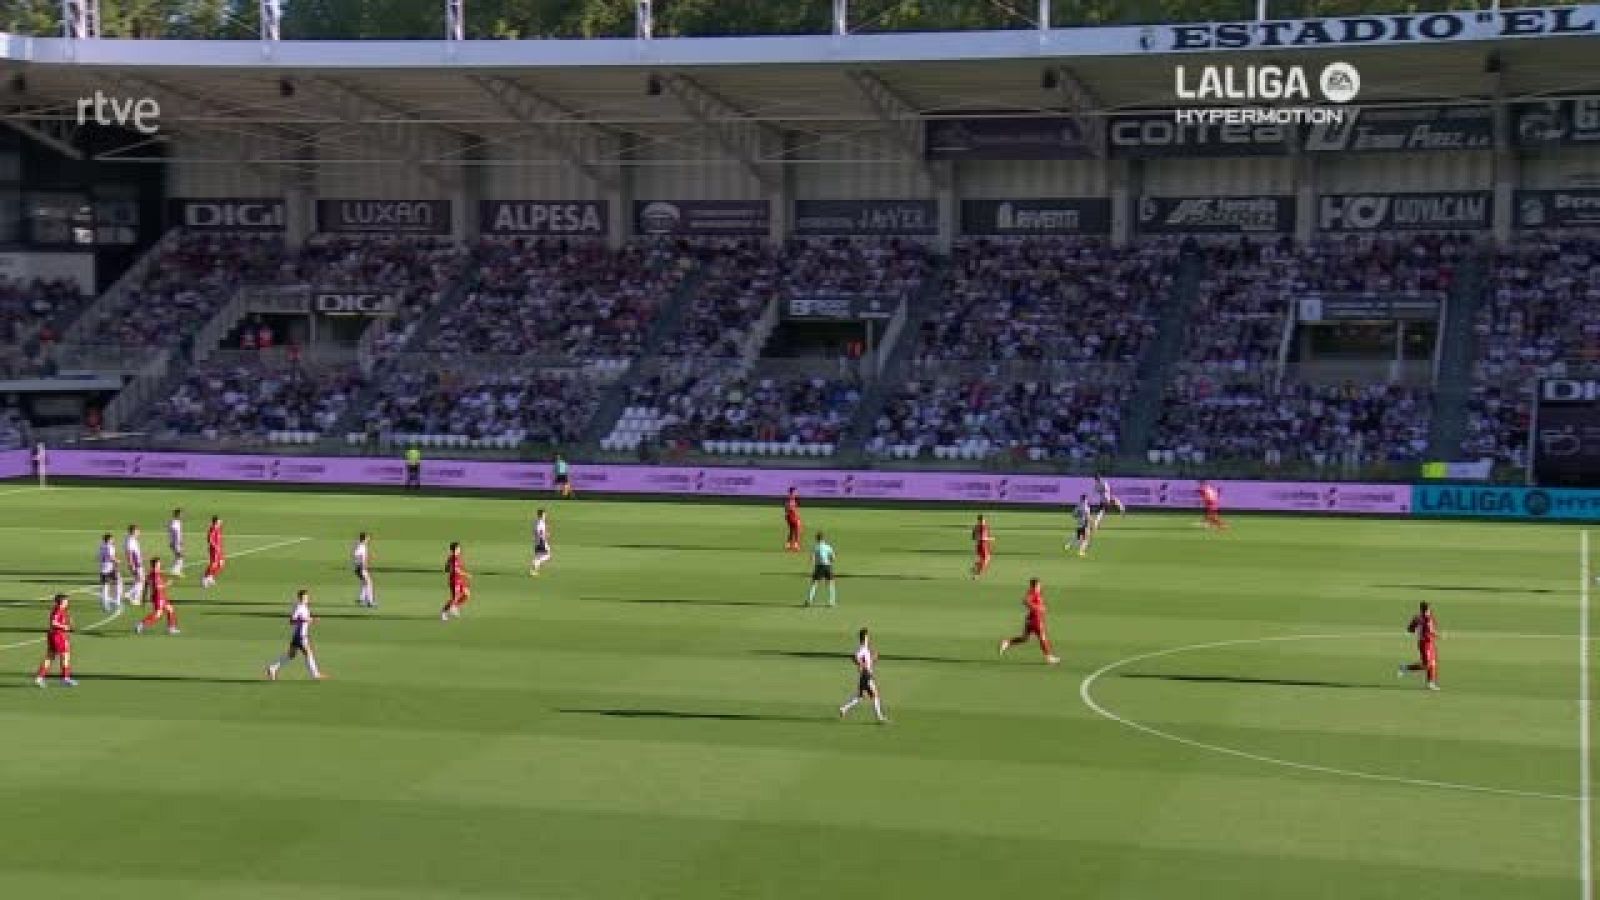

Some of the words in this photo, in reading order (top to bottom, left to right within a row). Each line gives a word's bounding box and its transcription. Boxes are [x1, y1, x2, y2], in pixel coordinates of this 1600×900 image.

[1171, 14, 1465, 51] ESTADIO
[185, 204, 283, 226] DIGI
[494, 204, 600, 231] ALPESA
[1544, 380, 1600, 400] DI
[1420, 488, 1517, 512] LALIGA
